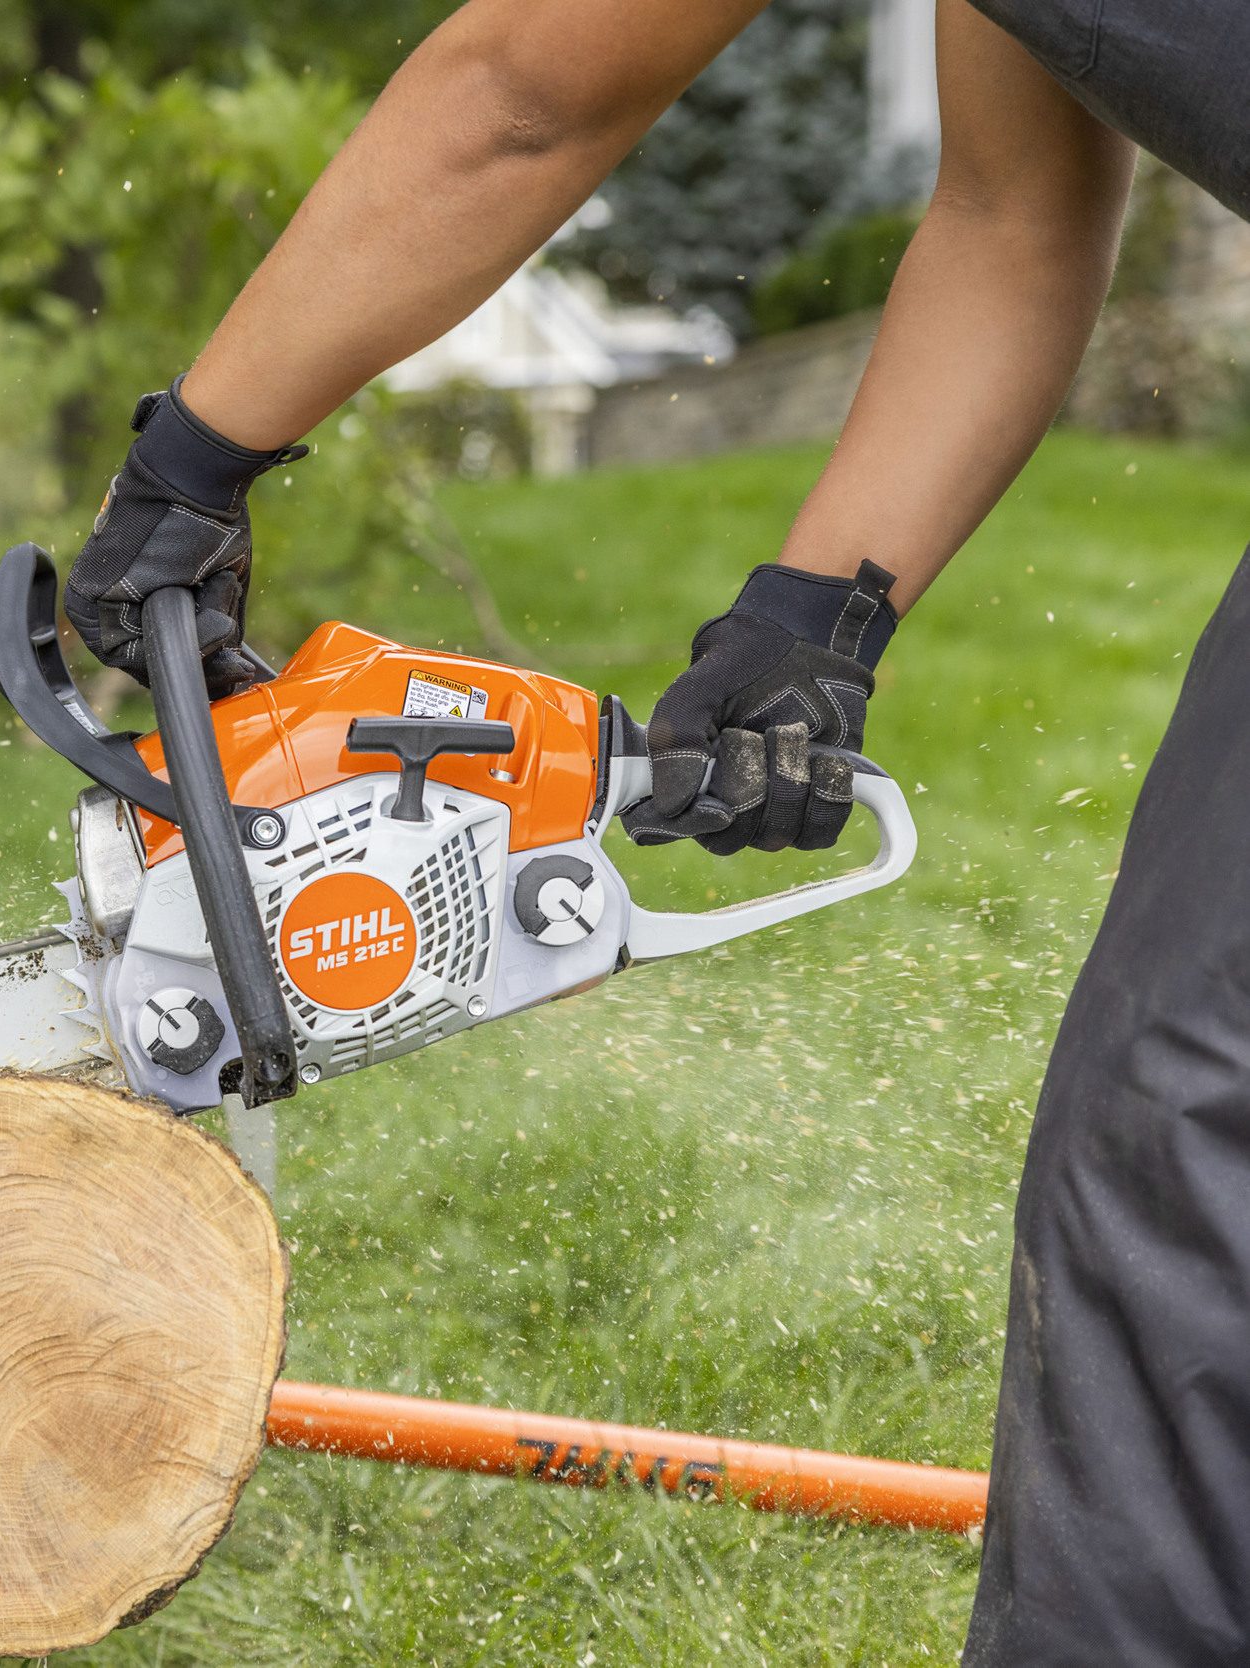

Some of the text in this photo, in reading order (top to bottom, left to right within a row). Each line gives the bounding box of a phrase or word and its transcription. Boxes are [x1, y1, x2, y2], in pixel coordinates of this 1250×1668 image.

[411, 686, 422, 694] with
[420, 682, 439, 692] tighten
[452, 692, 468, 701] insert
[424, 674, 467, 693] WARNING
[289, 907, 405, 960] STIHL
[316, 936, 404, 973] MS 212 C
